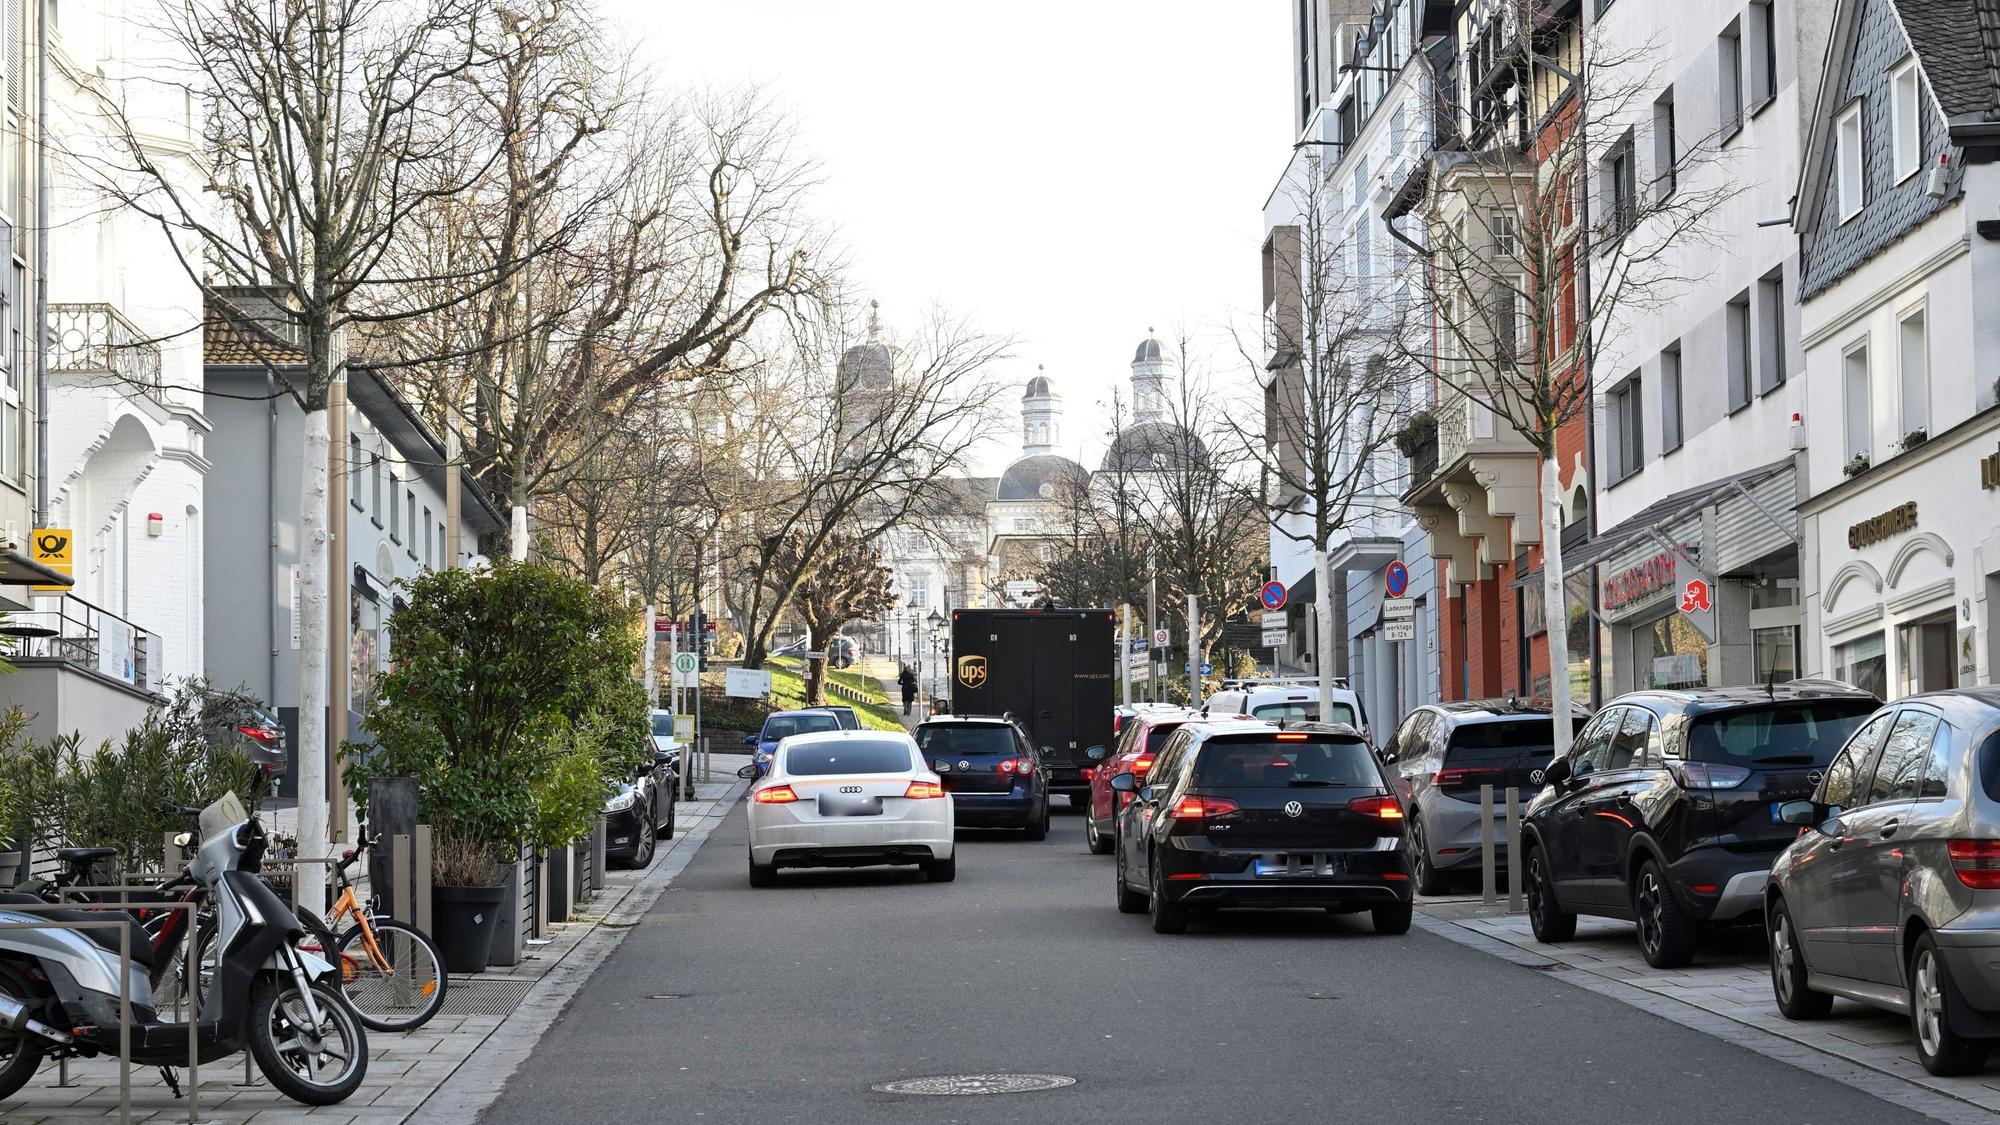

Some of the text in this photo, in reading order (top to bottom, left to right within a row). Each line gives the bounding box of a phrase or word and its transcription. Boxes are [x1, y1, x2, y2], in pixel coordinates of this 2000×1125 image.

[1385, 604, 1412, 612] Ladezone
[1263, 616, 1286, 624] Ladezone
[1386, 624, 1413, 632] werktags
[960, 665, 985, 683] ups
